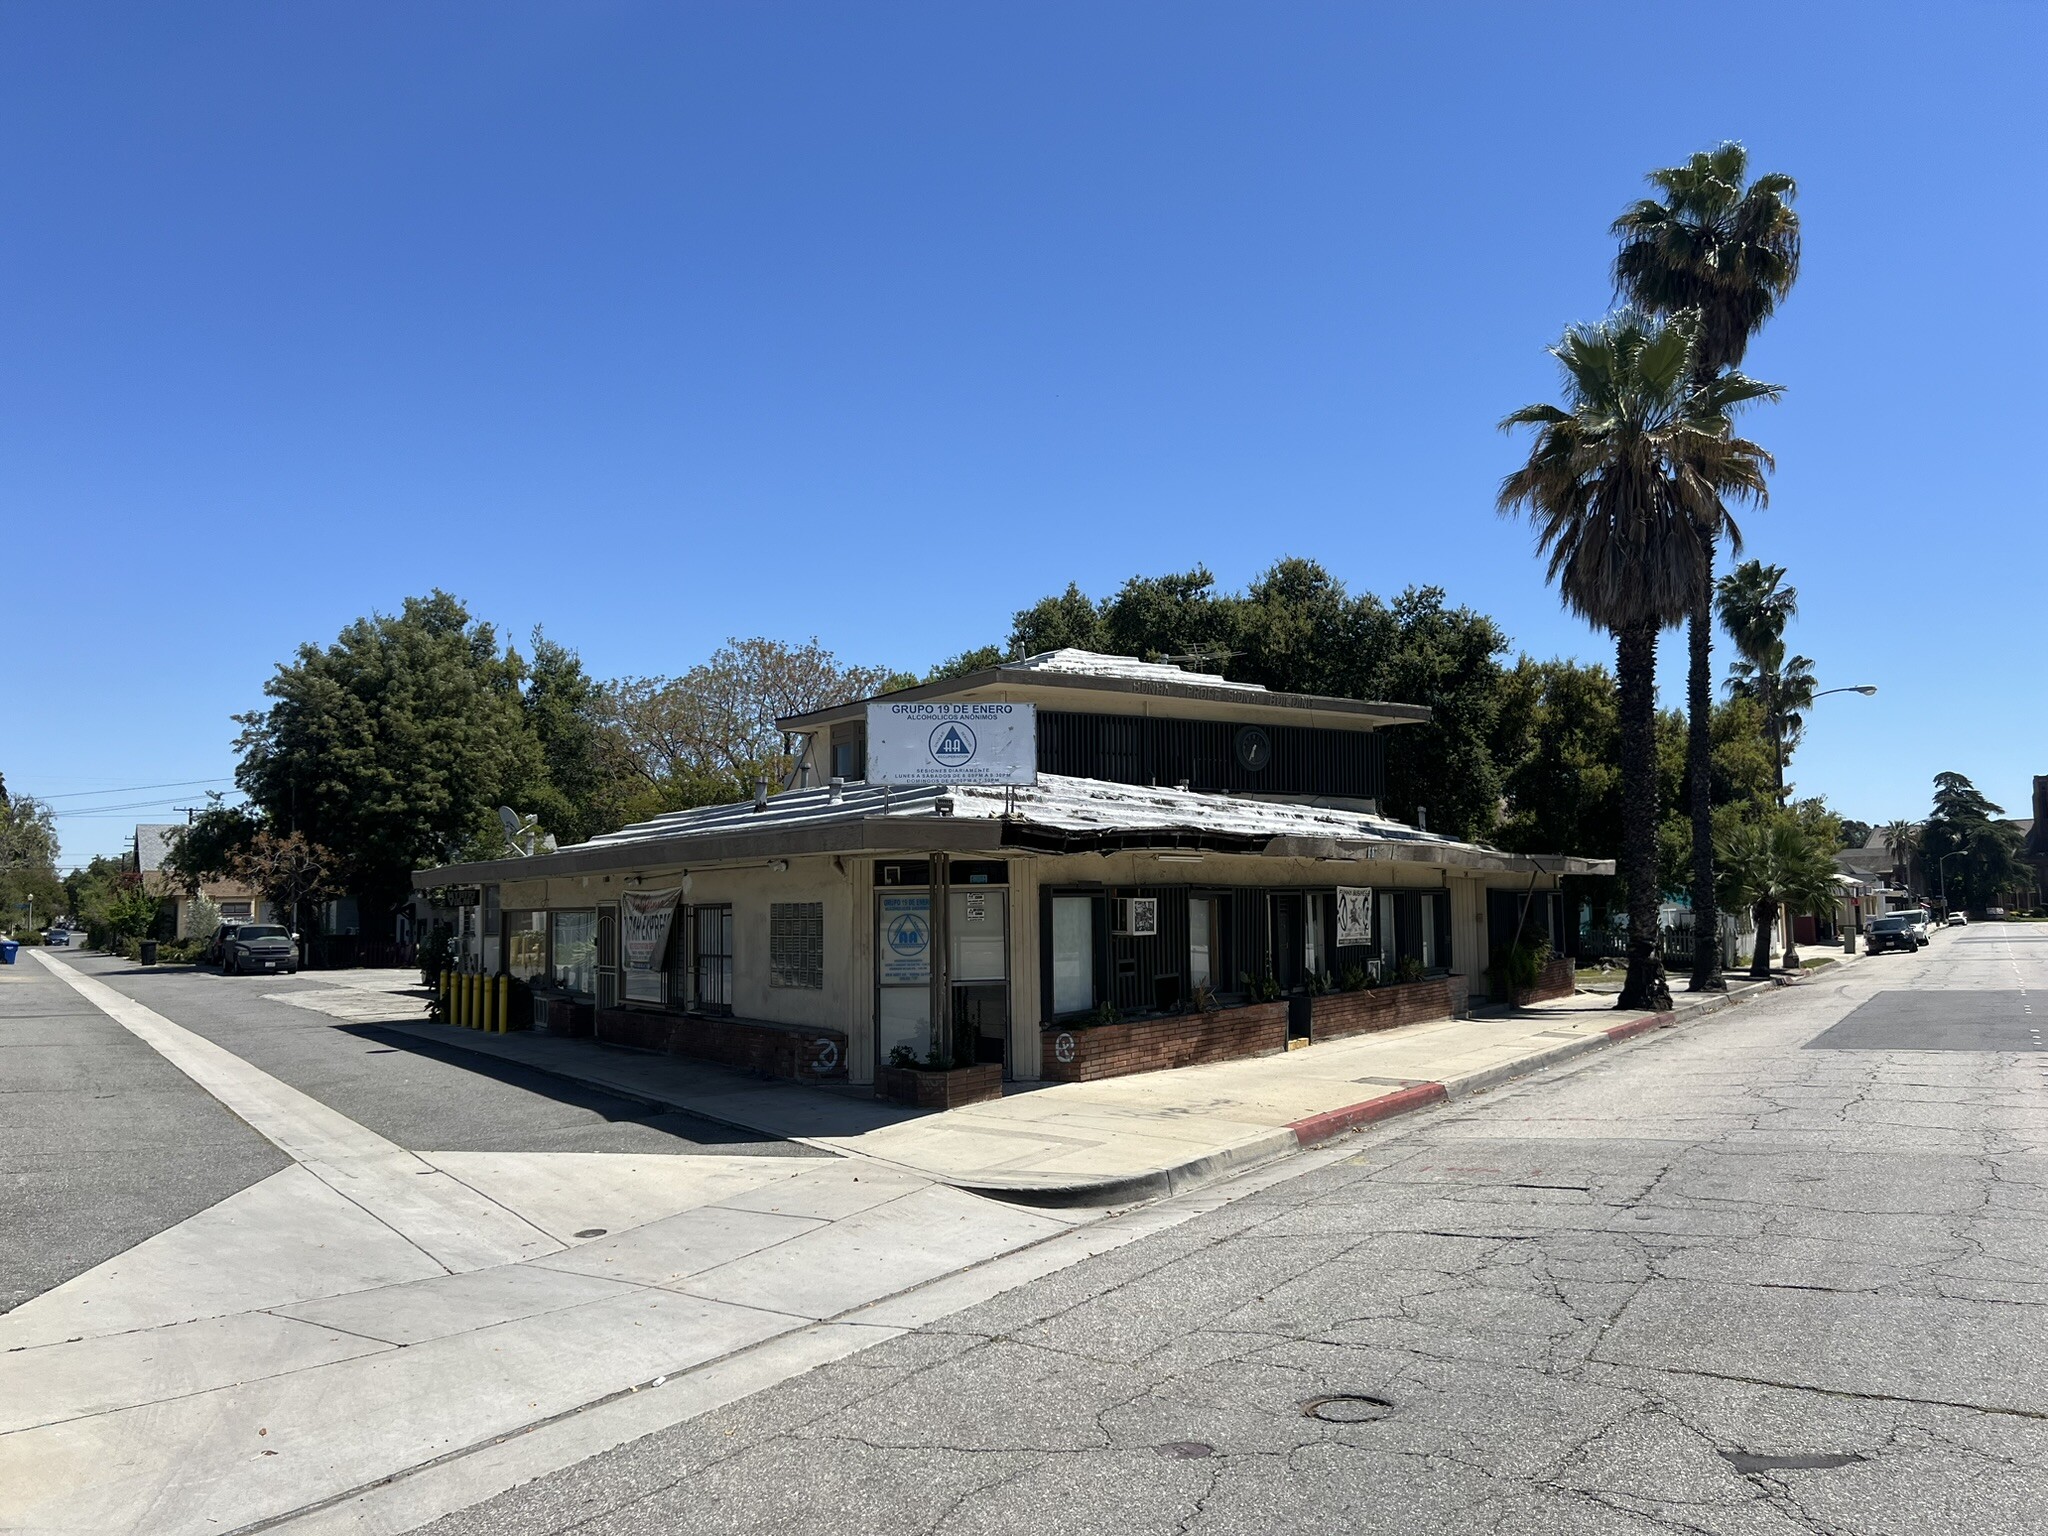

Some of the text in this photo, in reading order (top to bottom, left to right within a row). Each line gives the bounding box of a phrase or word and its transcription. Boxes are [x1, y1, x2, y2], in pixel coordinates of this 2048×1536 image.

[891, 705, 1013, 714] GRUPO 19 DE ENERO
[943, 739, 960, 752] AA
